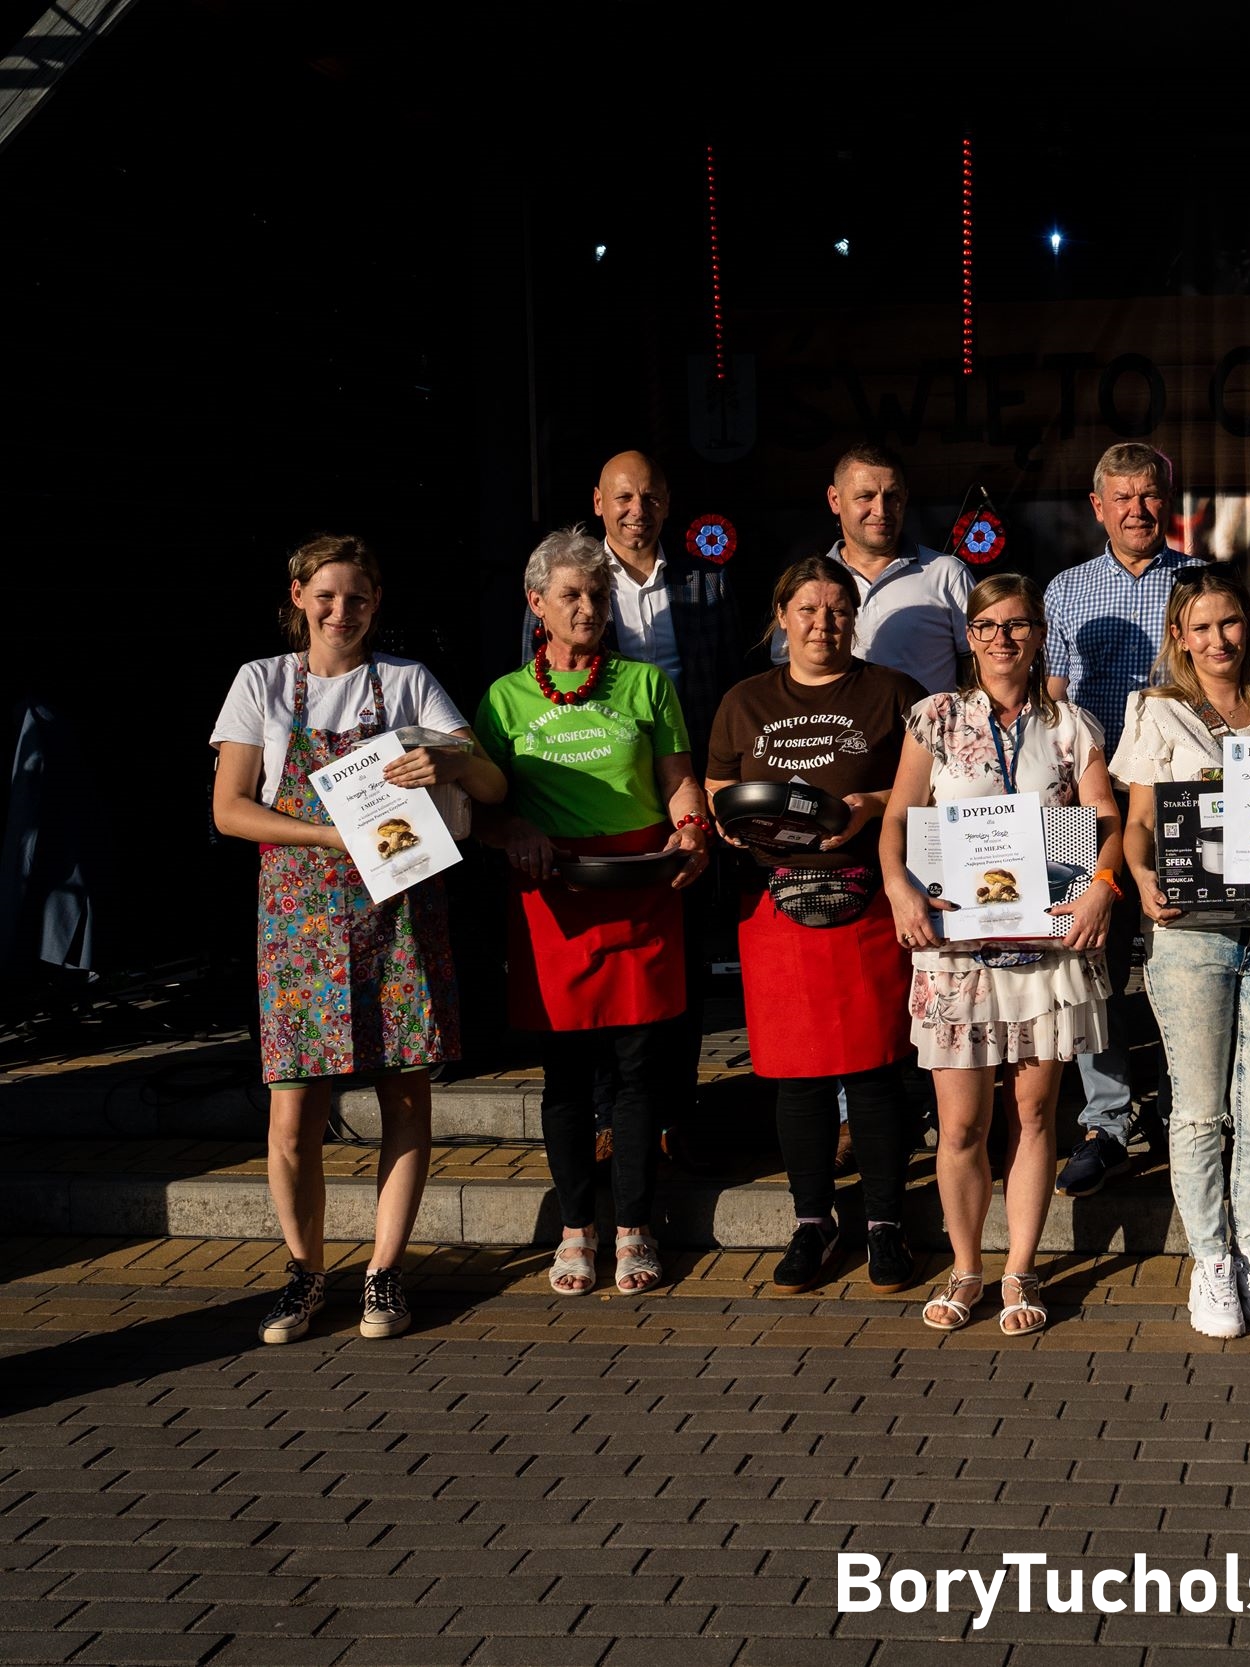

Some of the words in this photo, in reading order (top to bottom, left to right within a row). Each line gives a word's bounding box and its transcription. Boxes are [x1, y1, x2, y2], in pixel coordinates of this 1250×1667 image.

[779, 335, 1167, 471] ŚWIĘTO
[529, 703, 571, 731] ŚWIĘTO
[763, 716, 807, 734] ŚWIĘTO
[810, 714, 854, 728] GRZYBA
[546, 735, 556, 744] W
[557, 727, 606, 743] OSIECZNEJ
[773, 739, 785, 748] W
[785, 735, 833, 748] OSIECZNEJ
[542, 750, 552, 761] U
[553, 744, 612, 763] LASAKÓW
[767, 755, 778, 766] U
[778, 752, 835, 770] LASAKÓW
[333, 753, 381, 782] DYPLOM
[364, 793, 391, 810] MIEJSCA
[963, 804, 1015, 818] DYPLOM
[984, 845, 1012, 853] MIEJSCA
[1165, 858, 1192, 866] SFERA
